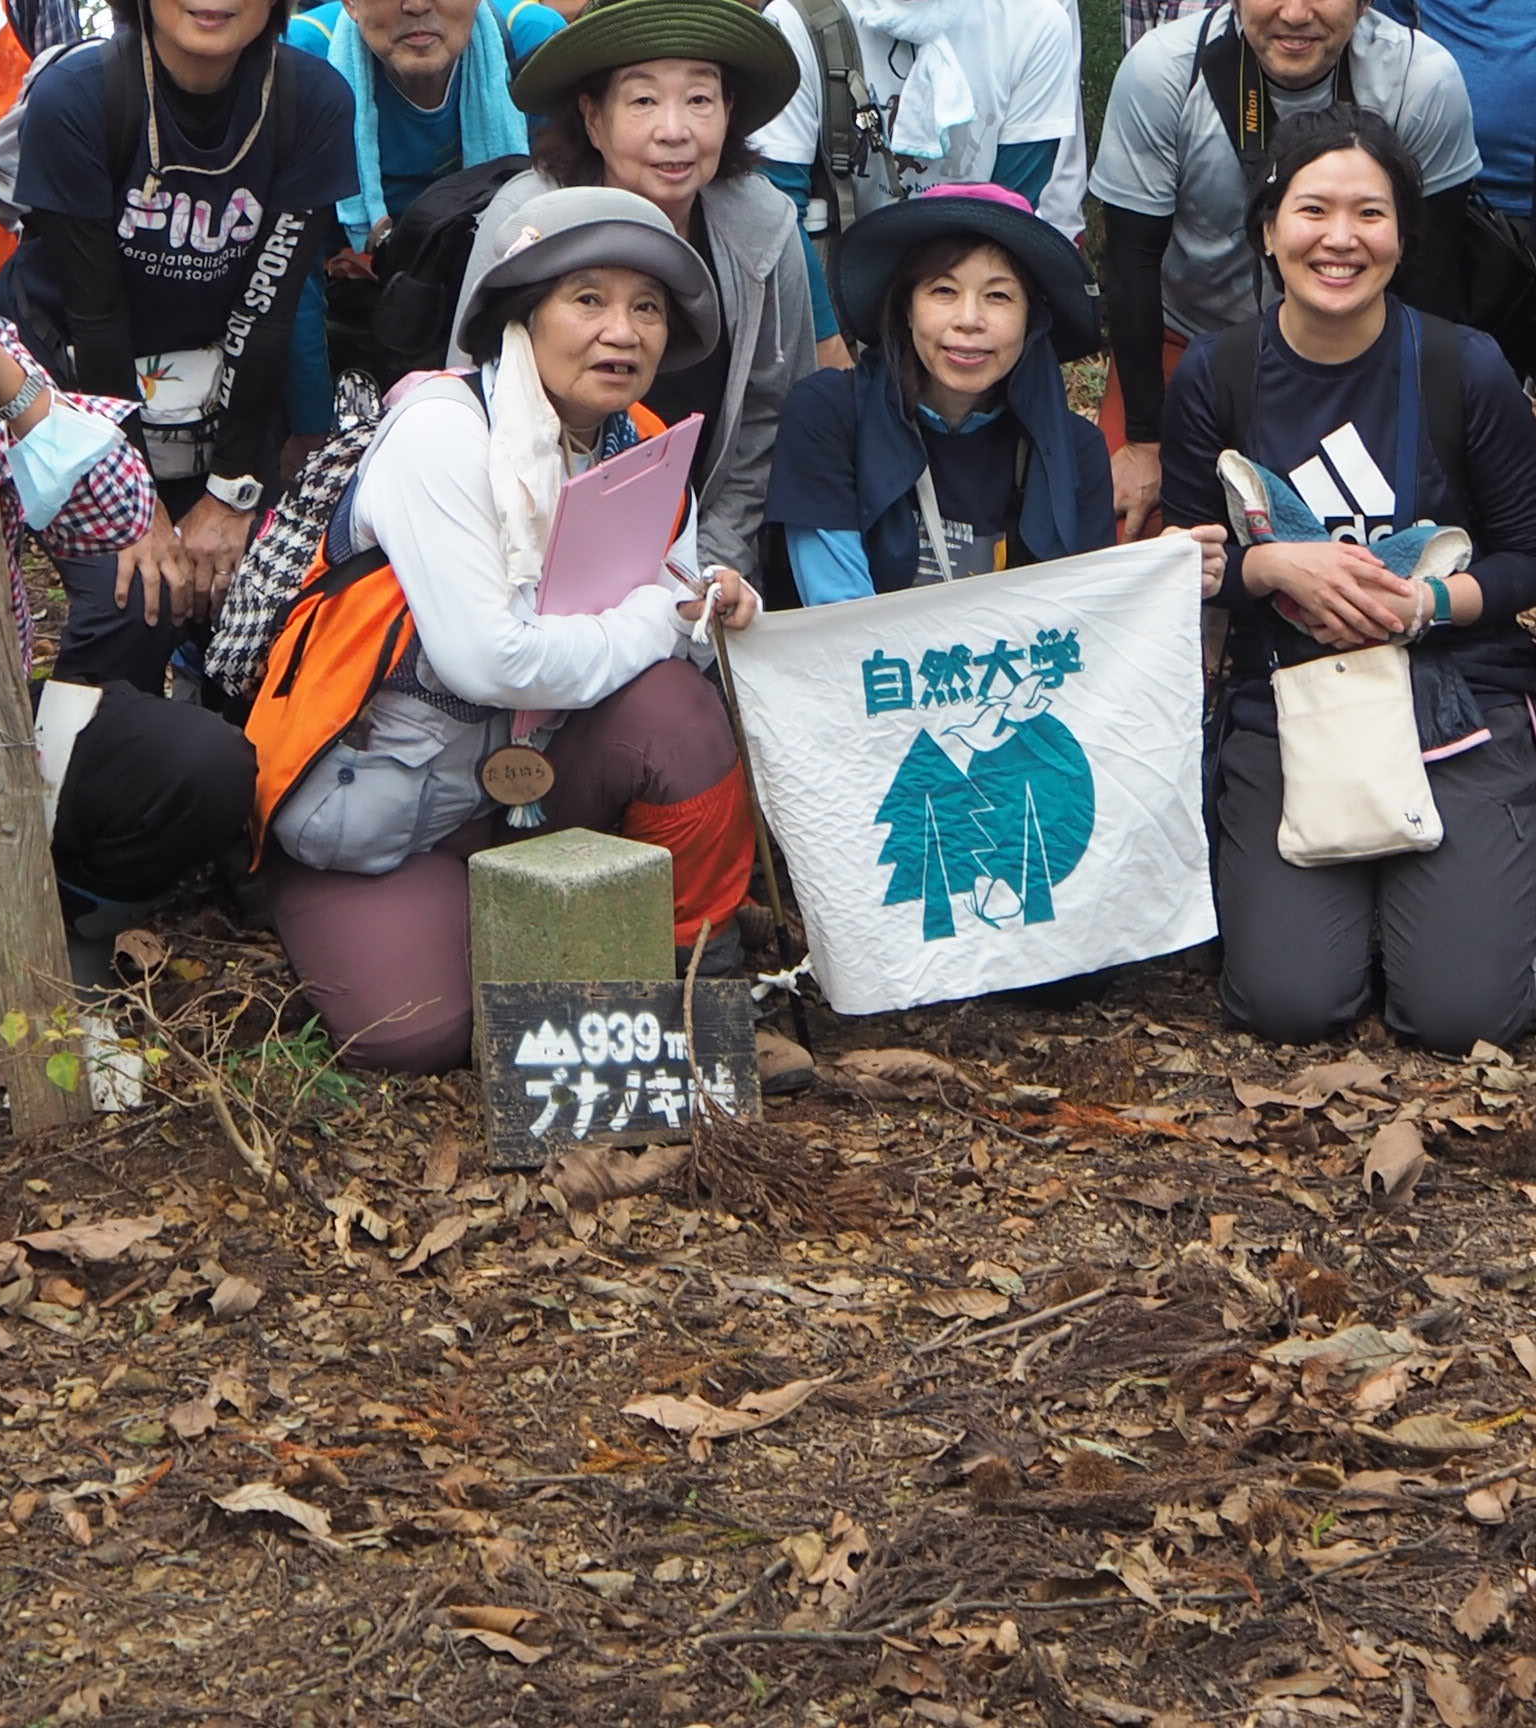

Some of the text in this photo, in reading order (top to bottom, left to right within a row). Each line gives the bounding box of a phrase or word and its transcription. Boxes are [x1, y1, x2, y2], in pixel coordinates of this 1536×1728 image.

[1246, 89, 1259, 133] Nikon
[117, 187, 264, 253] FILA
[145, 263, 230, 282] di un sogno
[244, 209, 313, 314] SPORT
[861, 627, 1086, 719] 自然大学
